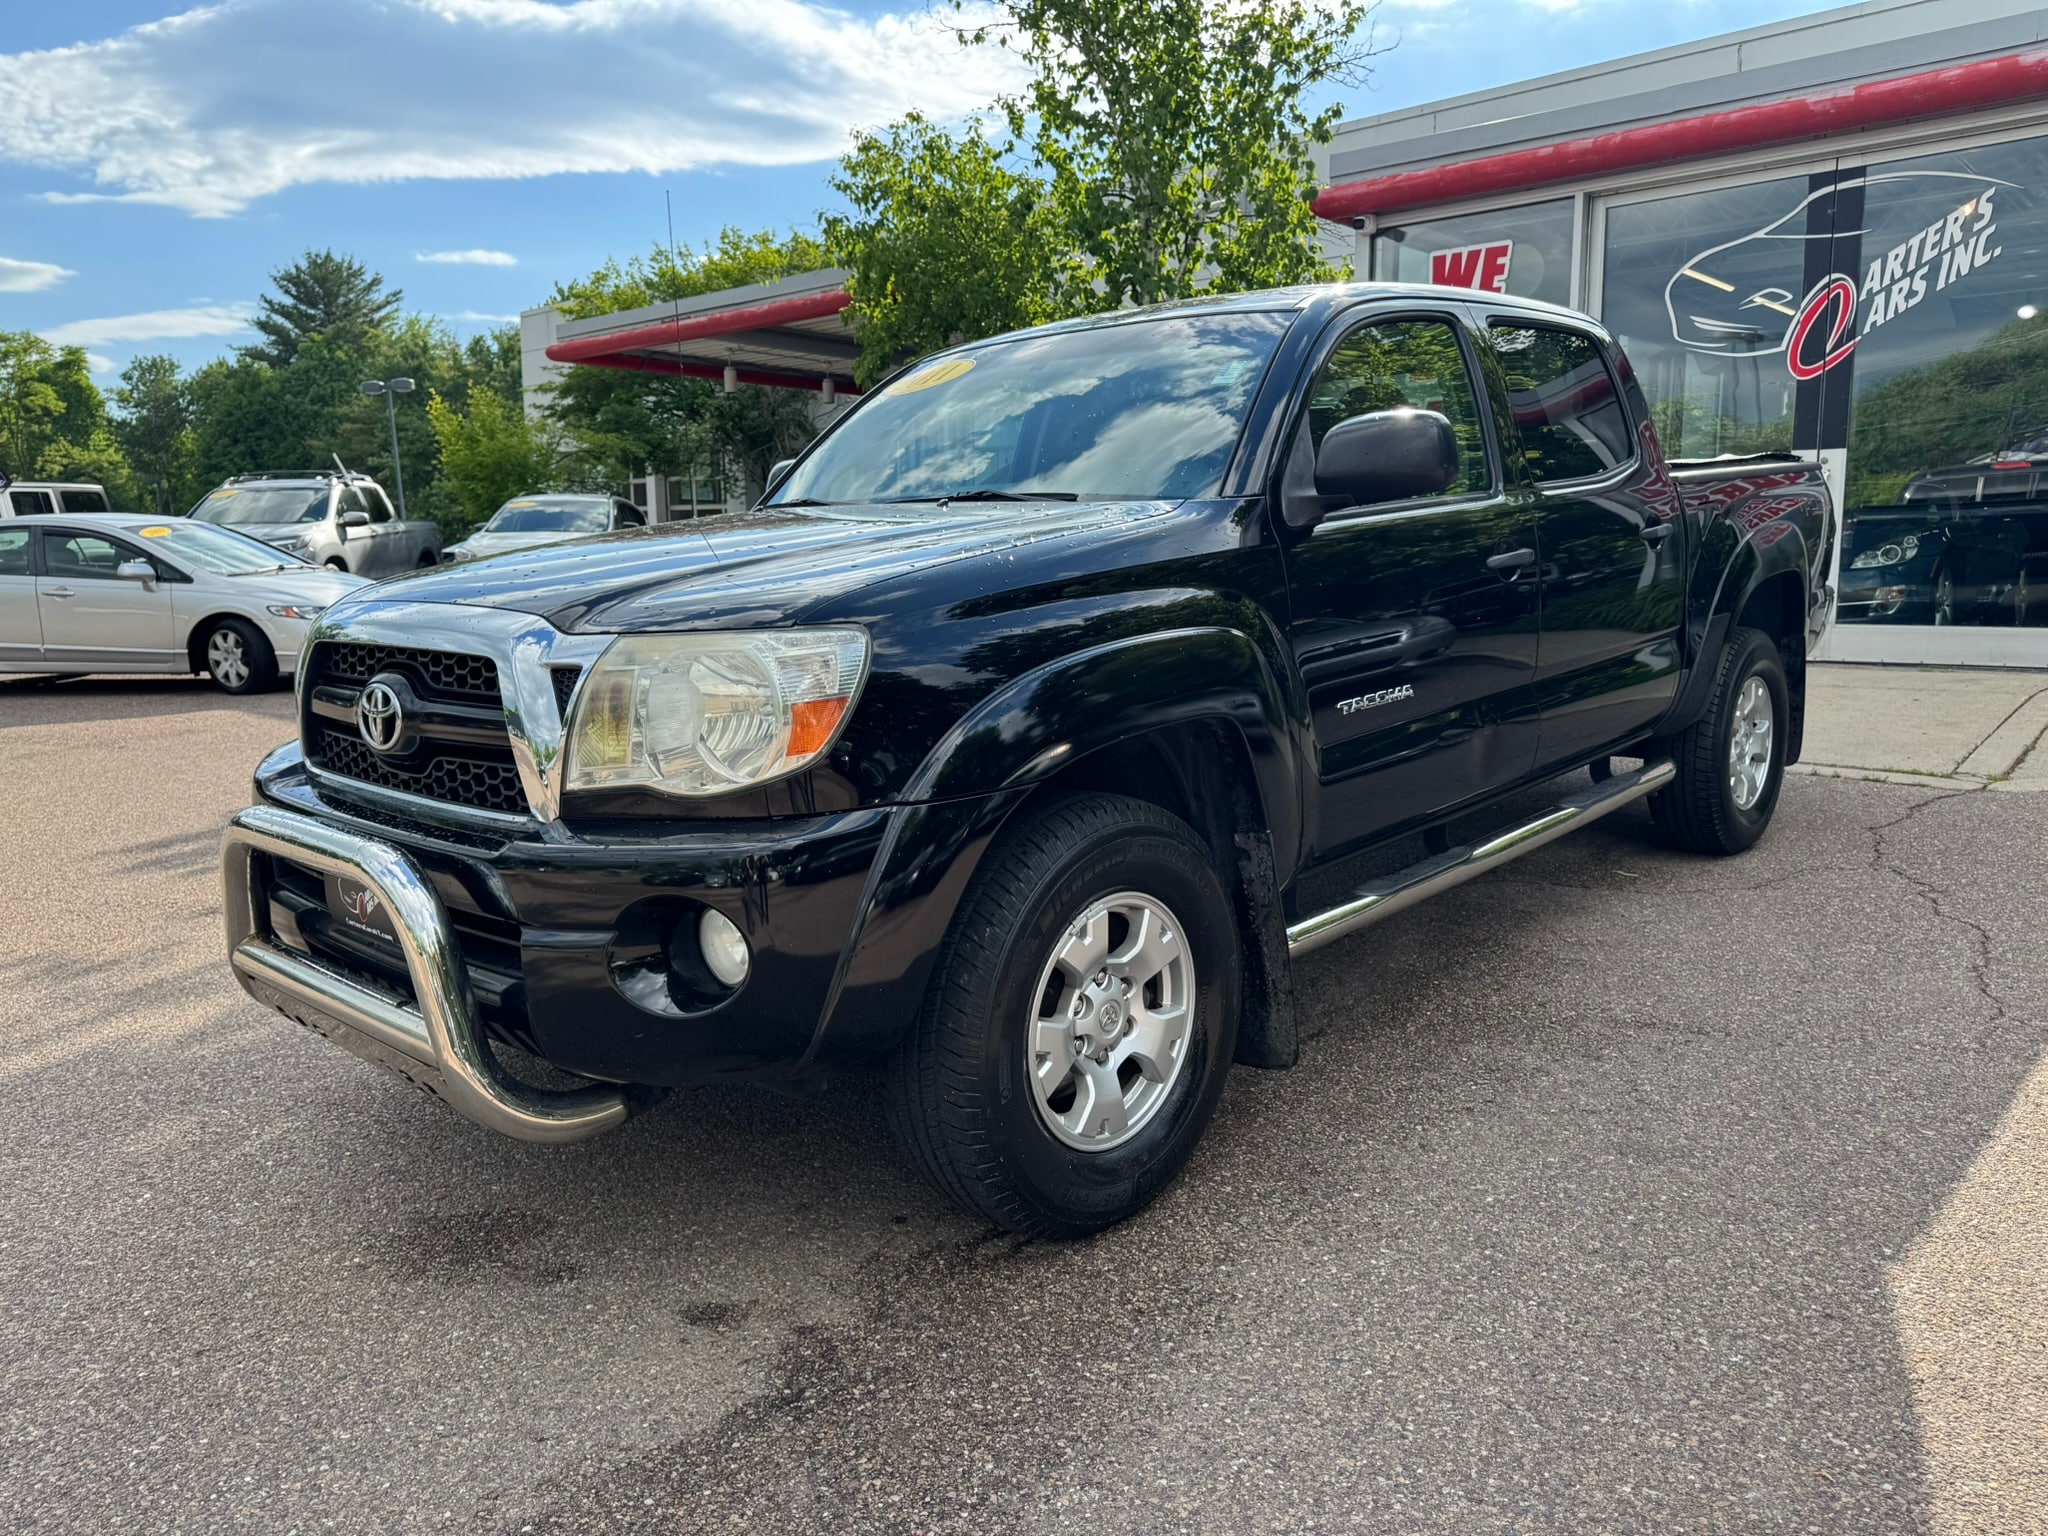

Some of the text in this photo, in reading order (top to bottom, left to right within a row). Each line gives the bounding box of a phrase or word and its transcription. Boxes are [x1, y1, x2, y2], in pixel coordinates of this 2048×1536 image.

[1430, 242, 1511, 293] WE
[1936, 223, 2002, 292] INC.
[1337, 684, 1414, 715] TACOMA
